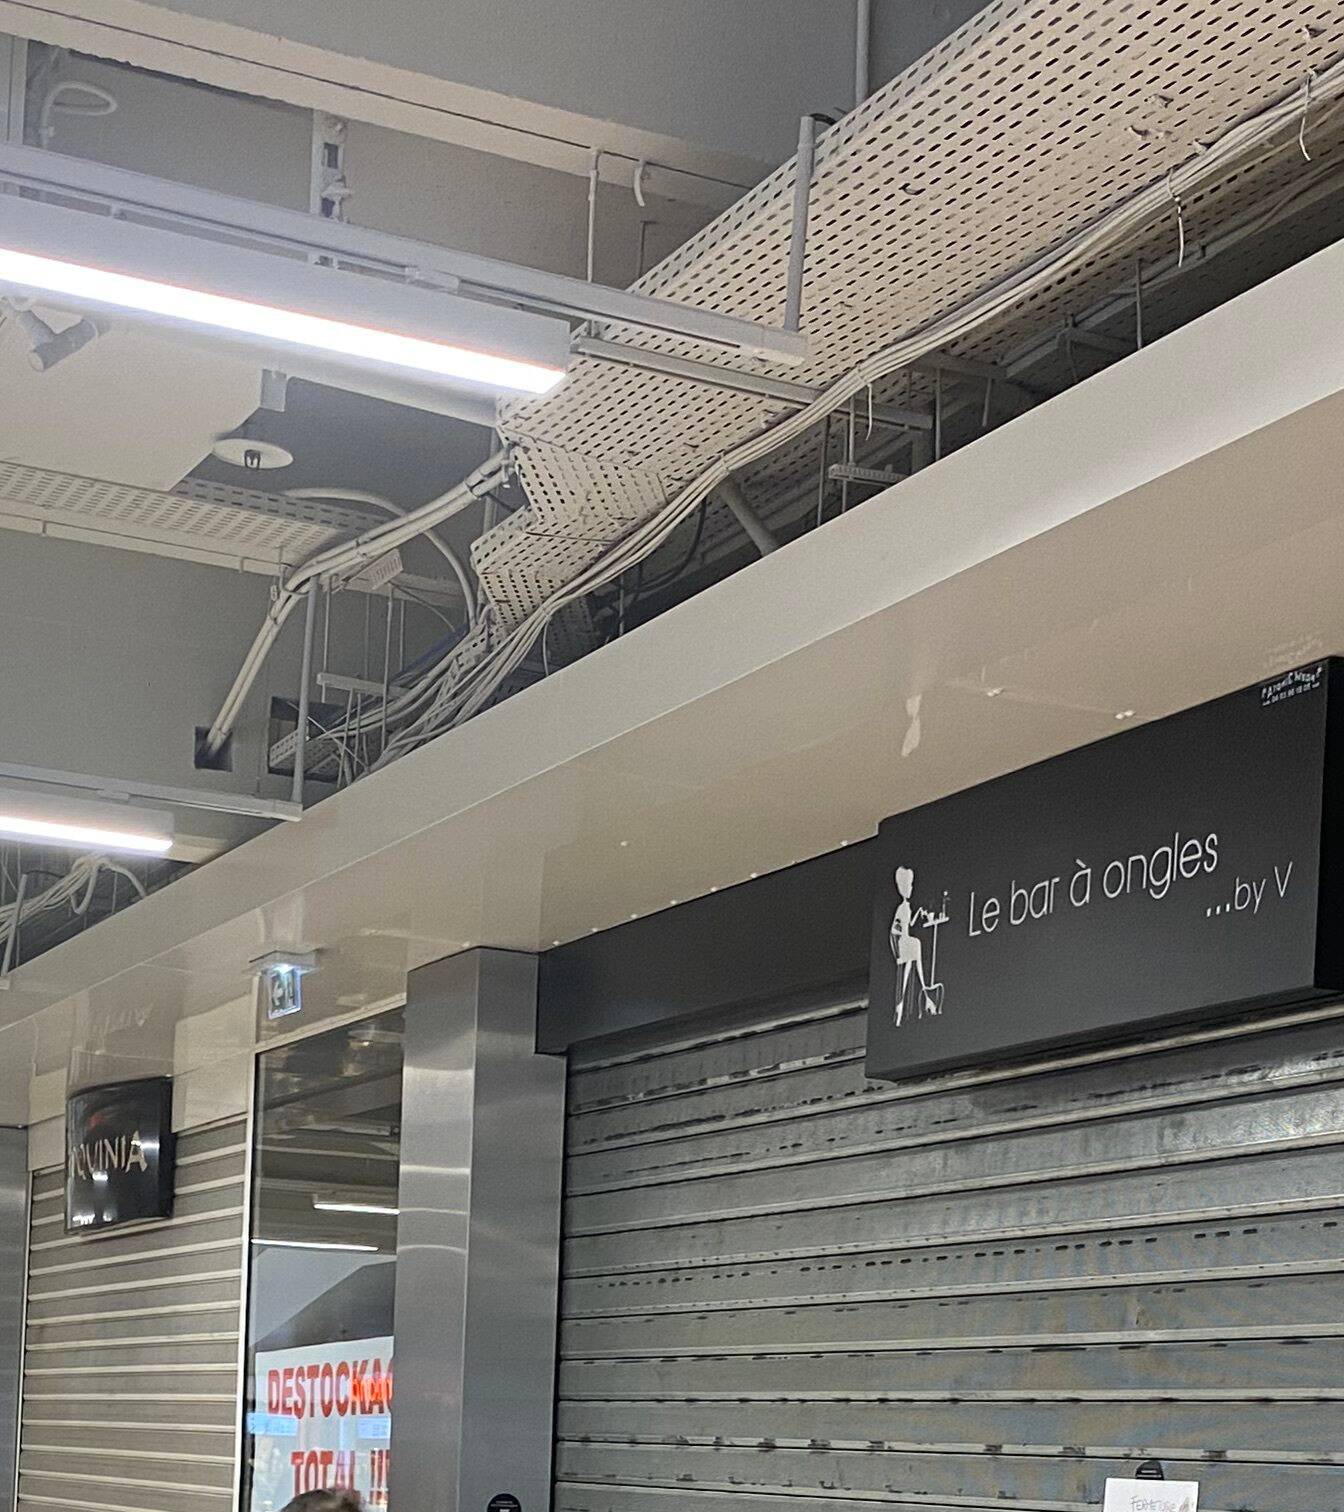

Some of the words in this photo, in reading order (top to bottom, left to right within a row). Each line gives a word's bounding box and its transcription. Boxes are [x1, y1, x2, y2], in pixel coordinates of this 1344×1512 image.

[968, 891, 1000, 936] Le
[1010, 880, 1060, 925] bar
[1069, 858, 1092, 907] à
[1103, 832, 1218, 899] ongles
[1274, 861, 1293, 898] V
